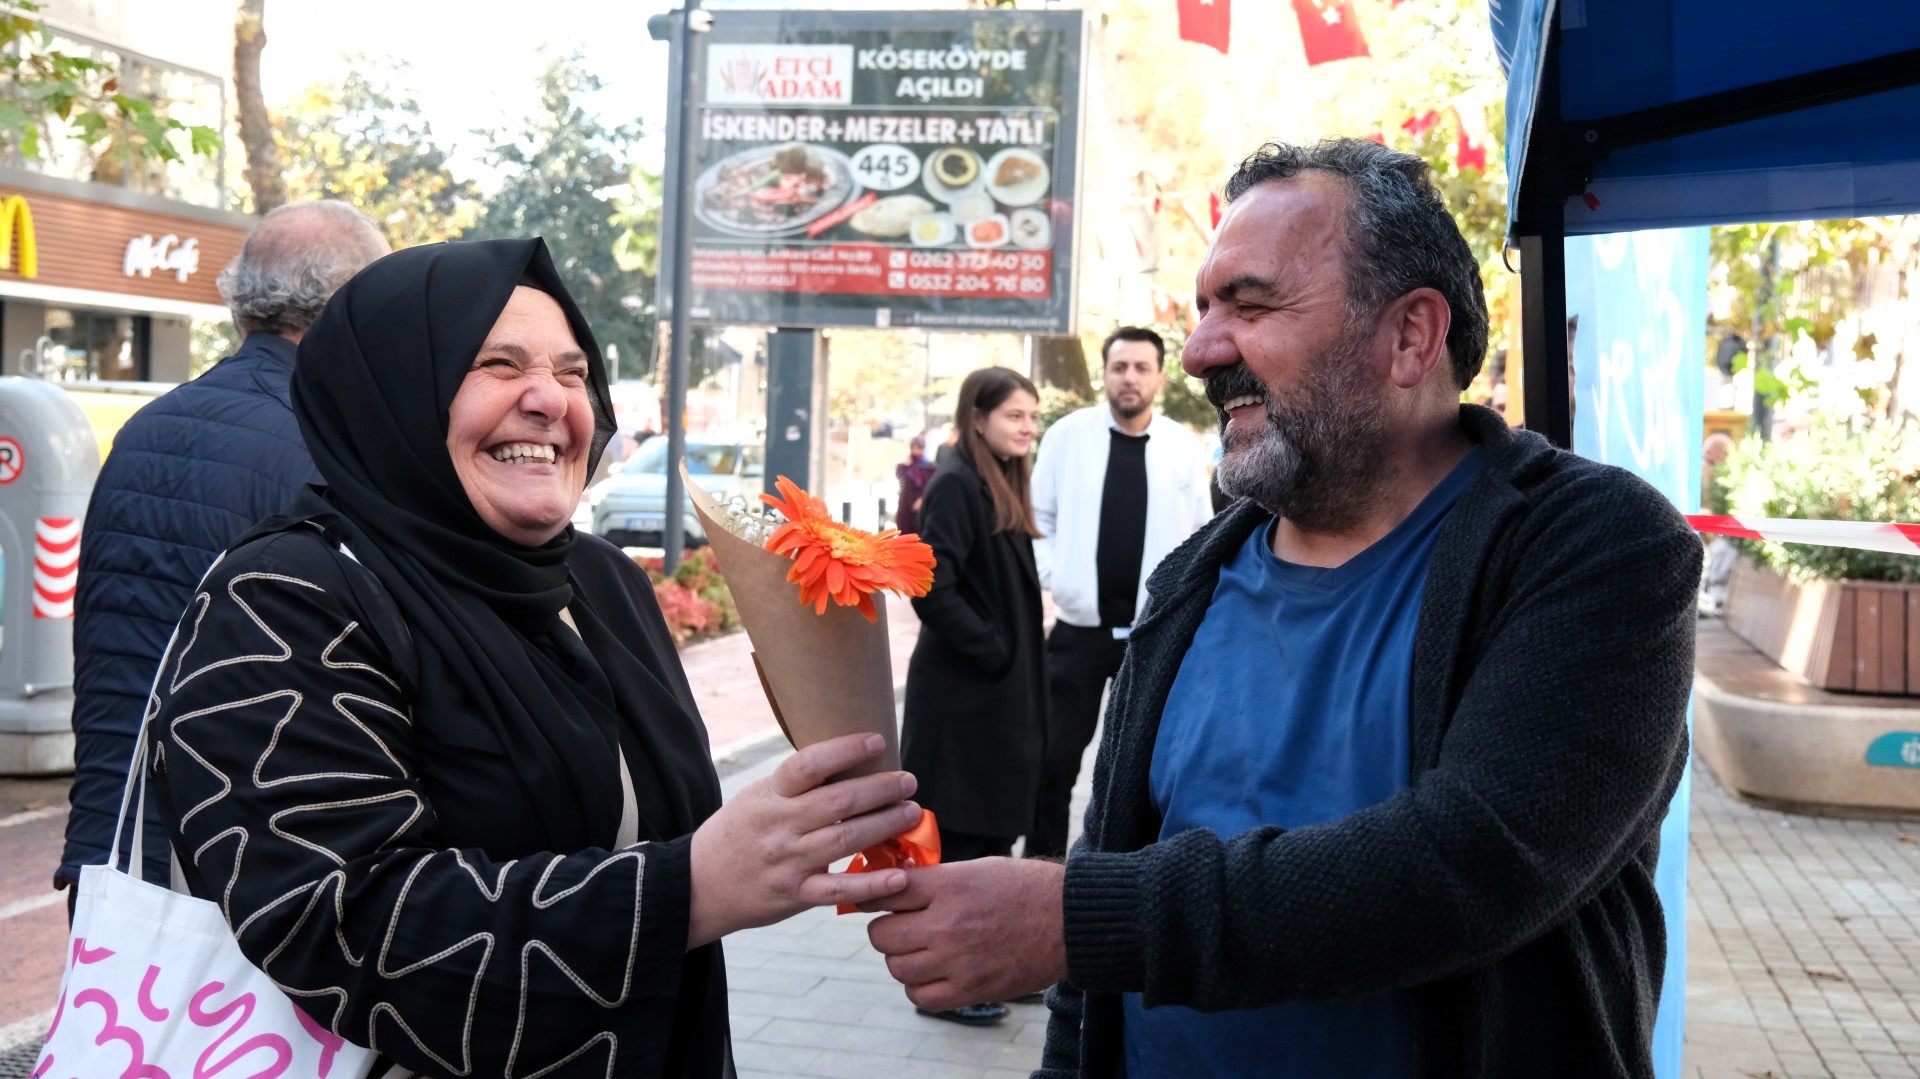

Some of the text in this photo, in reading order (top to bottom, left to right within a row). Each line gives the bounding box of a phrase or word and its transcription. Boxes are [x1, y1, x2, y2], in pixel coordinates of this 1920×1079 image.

[775, 52, 833, 79] ETÇİ
[858, 44, 1027, 70] KÖSEKÖY'DE
[764, 79, 842, 98] ADAM
[896, 77, 984, 102] AÇILDI
[858, 154, 909, 176] 445
[909, 252, 954, 269] 0262
[991, 253, 1018, 270] 40
[1020, 254, 1046, 271] 50
[908, 274, 1046, 293] 0532 204 76 80
